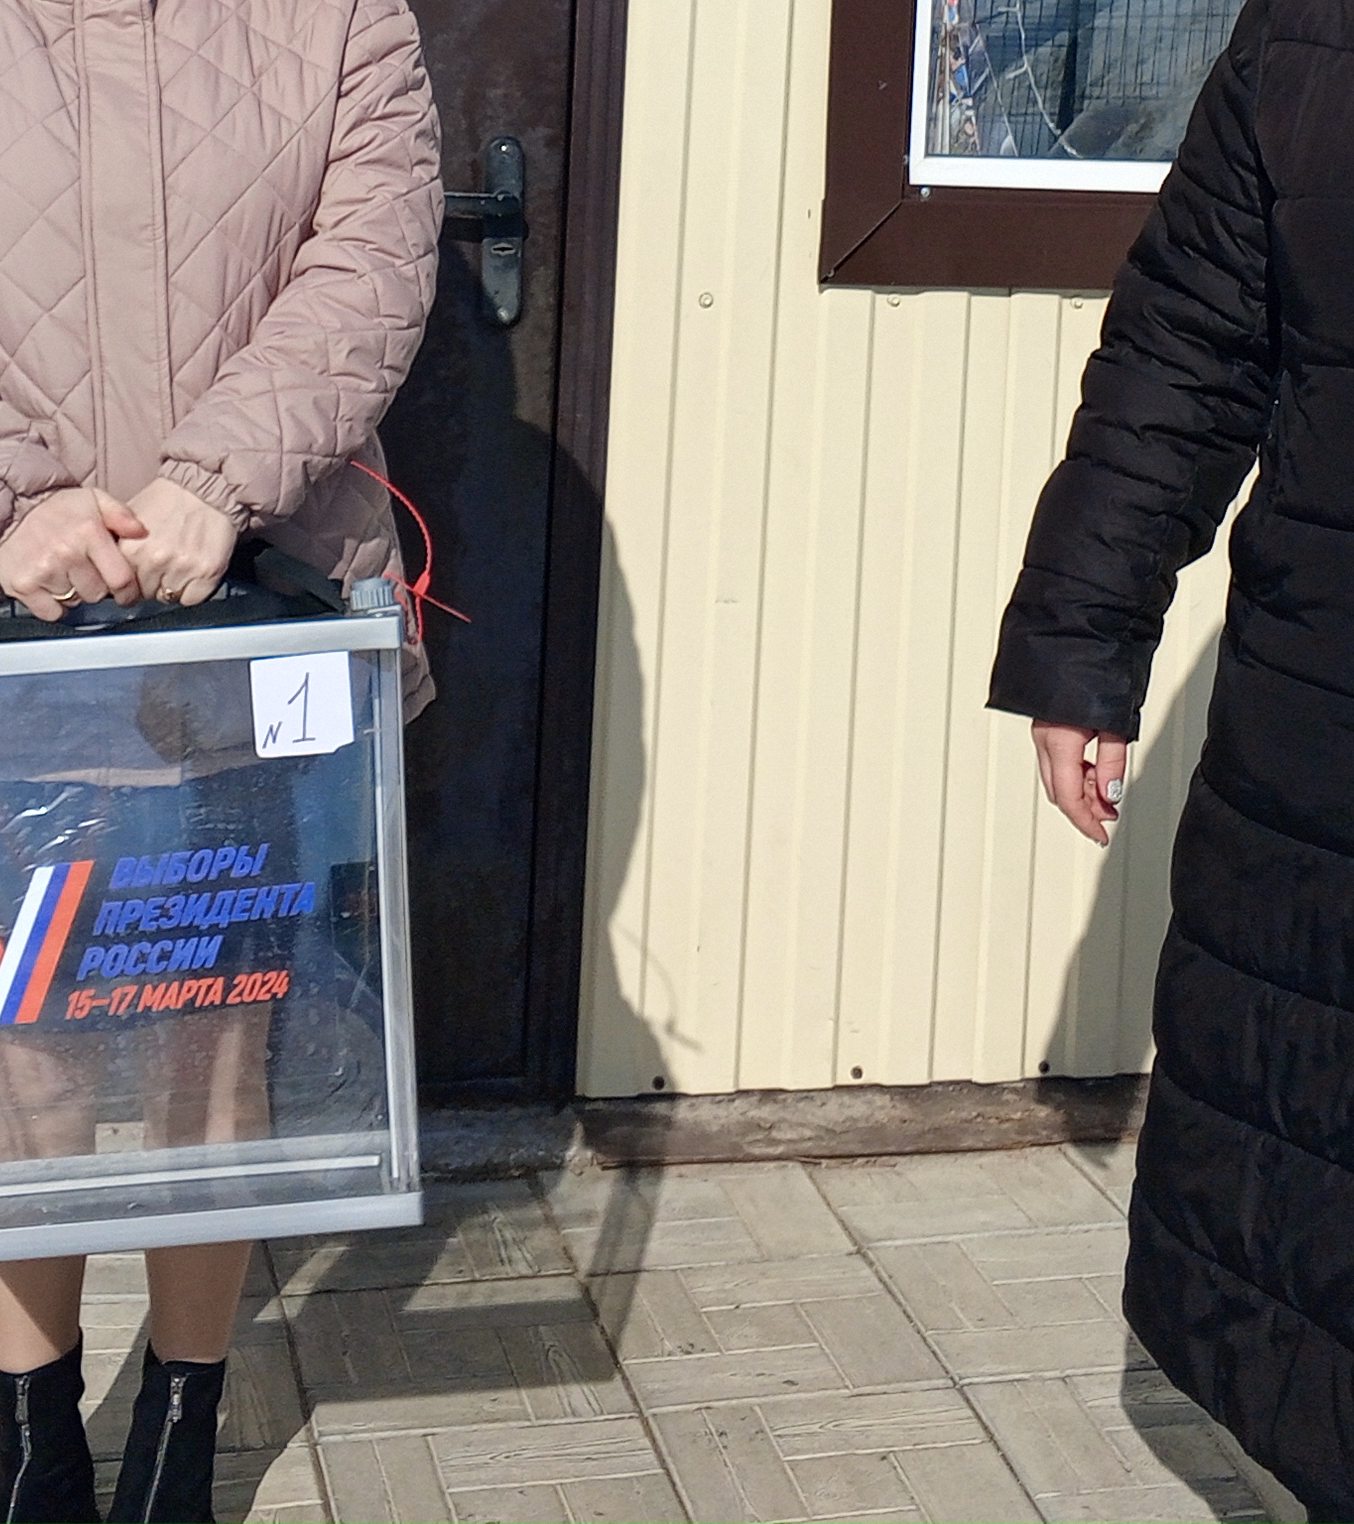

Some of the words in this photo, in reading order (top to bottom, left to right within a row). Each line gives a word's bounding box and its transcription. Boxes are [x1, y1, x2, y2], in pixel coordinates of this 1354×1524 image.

[109, 843, 270, 890] ВЫБОРЫ
[93, 881, 314, 936] ПРЕЗИДЕНТА
[76, 935, 223, 981] РОССИИ
[143, 977, 225, 1011] МАРТА
[226, 970, 290, 1004] 2024
